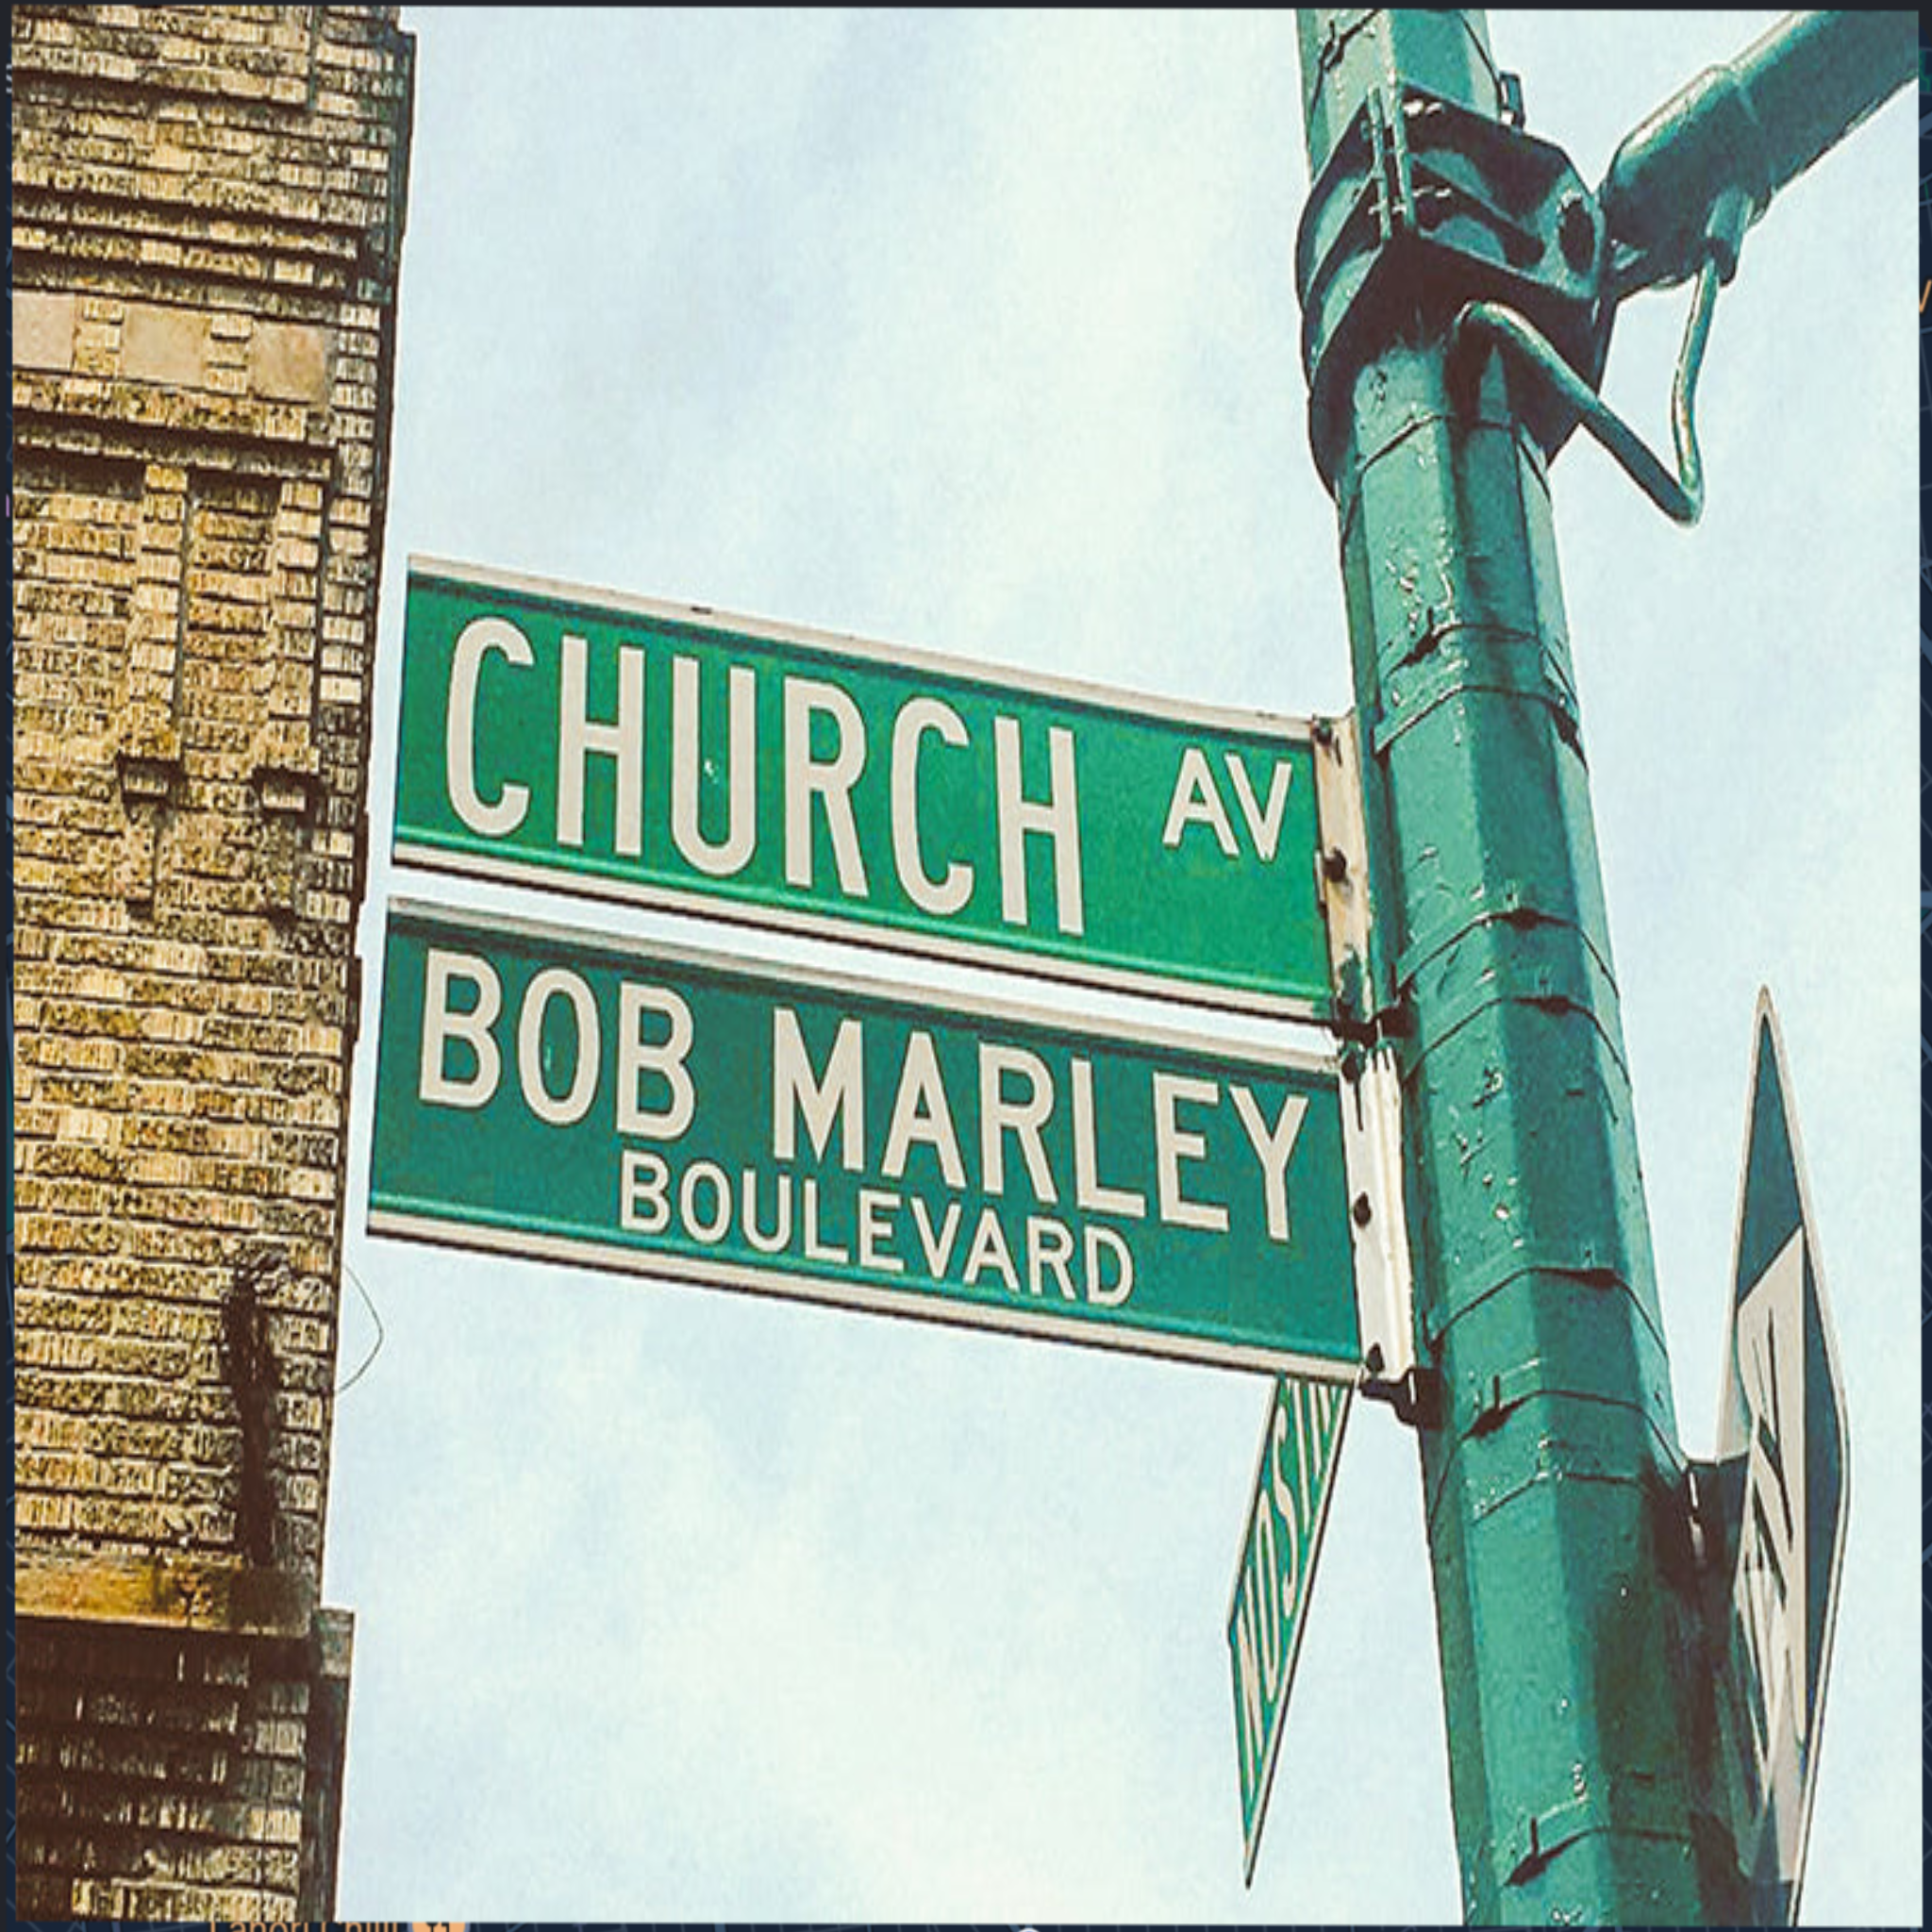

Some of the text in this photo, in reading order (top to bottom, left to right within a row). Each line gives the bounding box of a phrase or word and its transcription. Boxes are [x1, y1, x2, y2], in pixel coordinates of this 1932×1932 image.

[445, 616, 1292, 937] CHURCH AV
[419, 948, 1310, 1243] BOB MARLEY
[619, 1148, 1135, 1308] BOULEVARD
